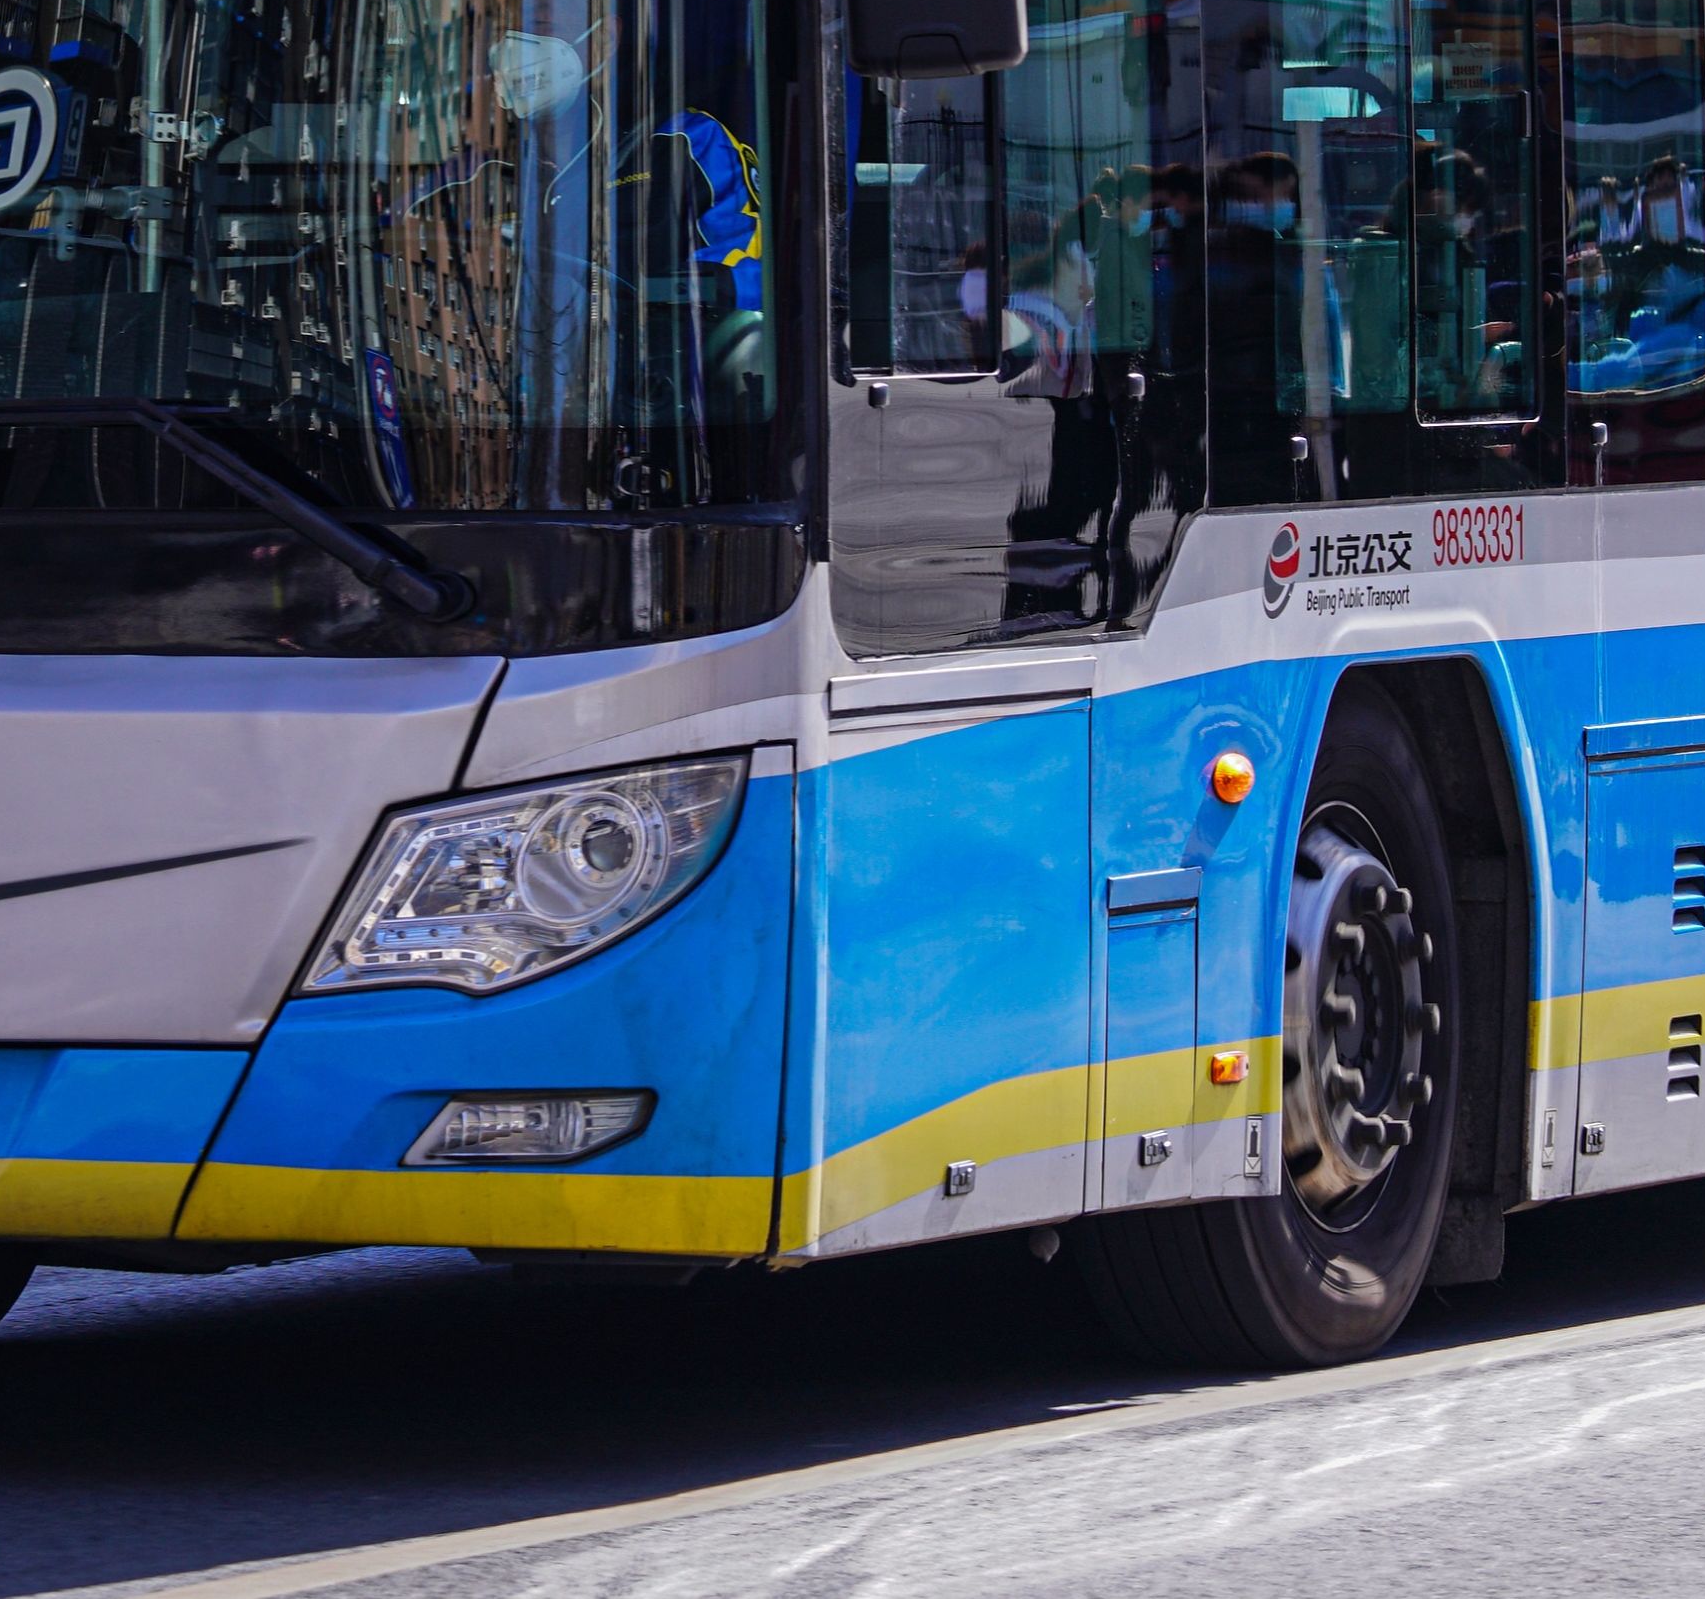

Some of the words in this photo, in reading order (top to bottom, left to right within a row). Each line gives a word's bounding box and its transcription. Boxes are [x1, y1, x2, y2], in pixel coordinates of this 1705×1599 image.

[1308, 531, 1413, 578] 北京公交
[1432, 503, 1525, 567] 9833331
[1306, 588, 1337, 616] Beijing
[1338, 586, 1365, 610] Public
[1367, 584, 1411, 610] Transport
